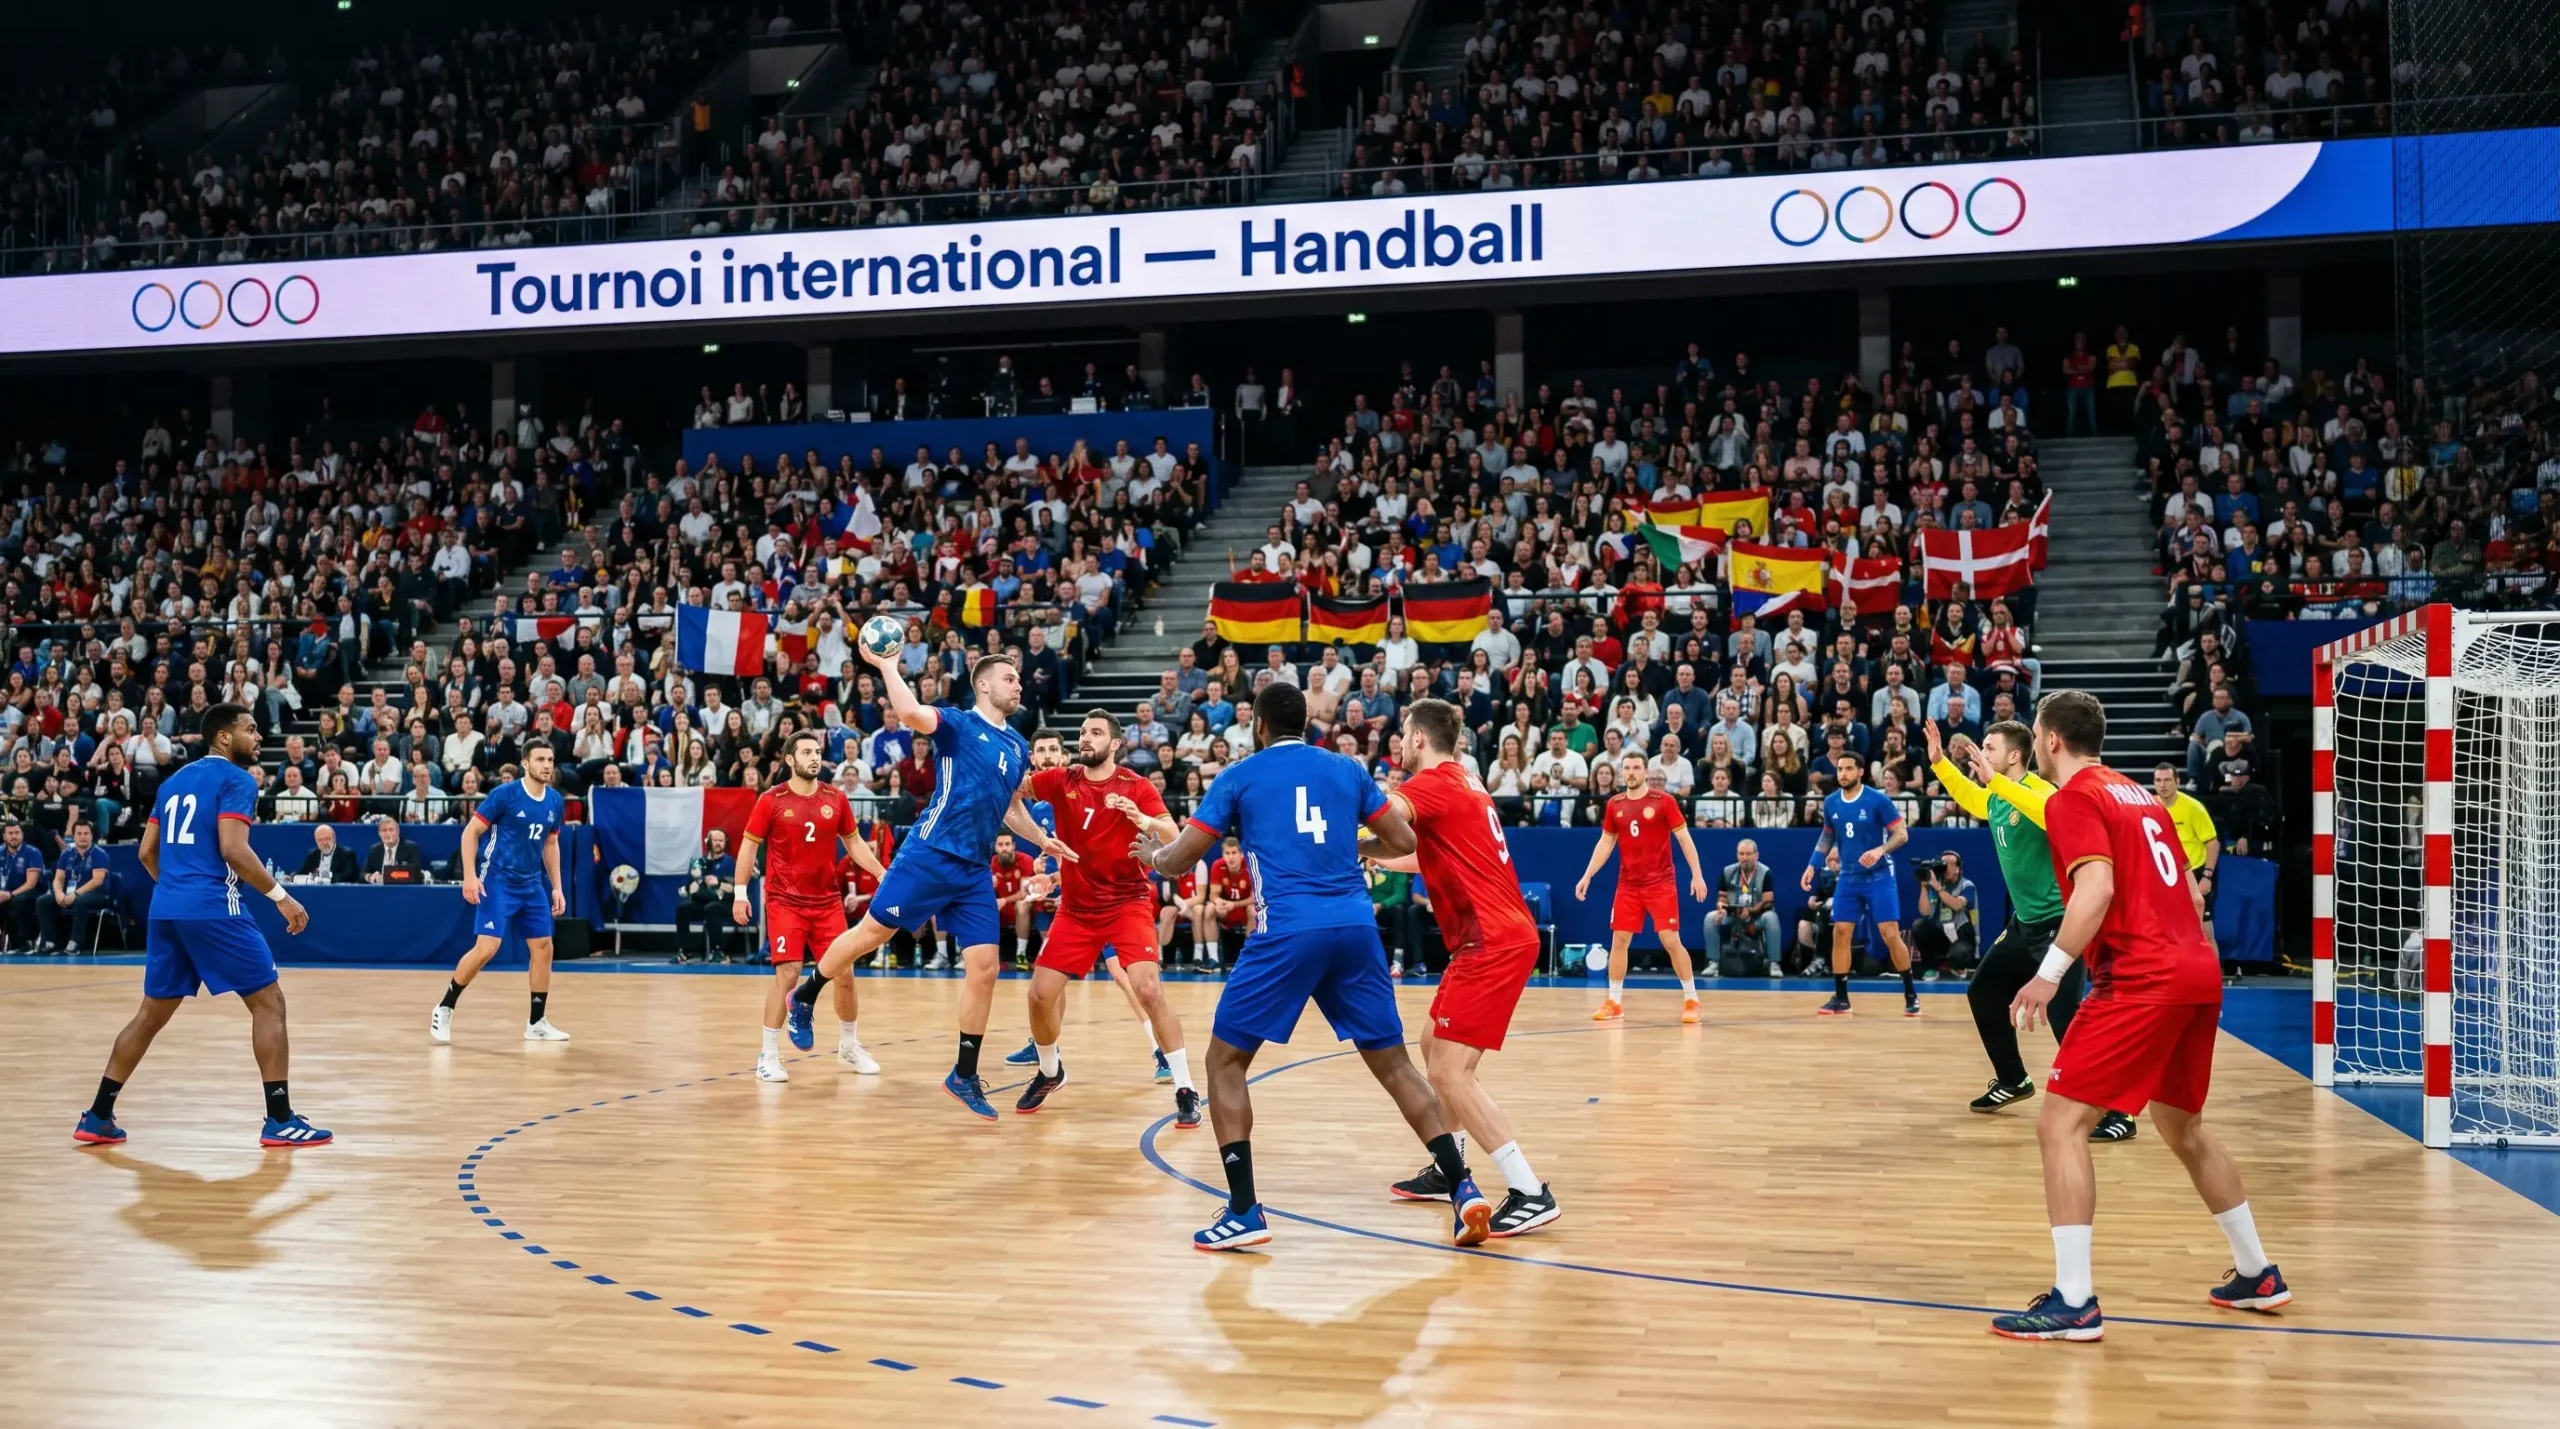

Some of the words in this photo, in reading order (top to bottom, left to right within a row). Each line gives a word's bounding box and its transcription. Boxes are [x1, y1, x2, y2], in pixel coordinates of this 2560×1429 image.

[476, 249, 702, 316] Tournoi
[723, 226, 1121, 304] international
[1241, 204, 1543, 277] Handball
[997, 751, 1009, 777] 4
[164, 793, 198, 845] 12
[1082, 807, 1095, 831] 7
[1295, 786, 1328, 844] 4
[528, 823, 544, 840] 12
[804, 821, 816, 843] 2
[1486, 804, 1510, 865] 9
[1629, 819, 1640, 837] 6
[1845, 821, 1855, 839] 8
[2141, 816, 2179, 888] 6
[776, 935, 787, 954] 2
